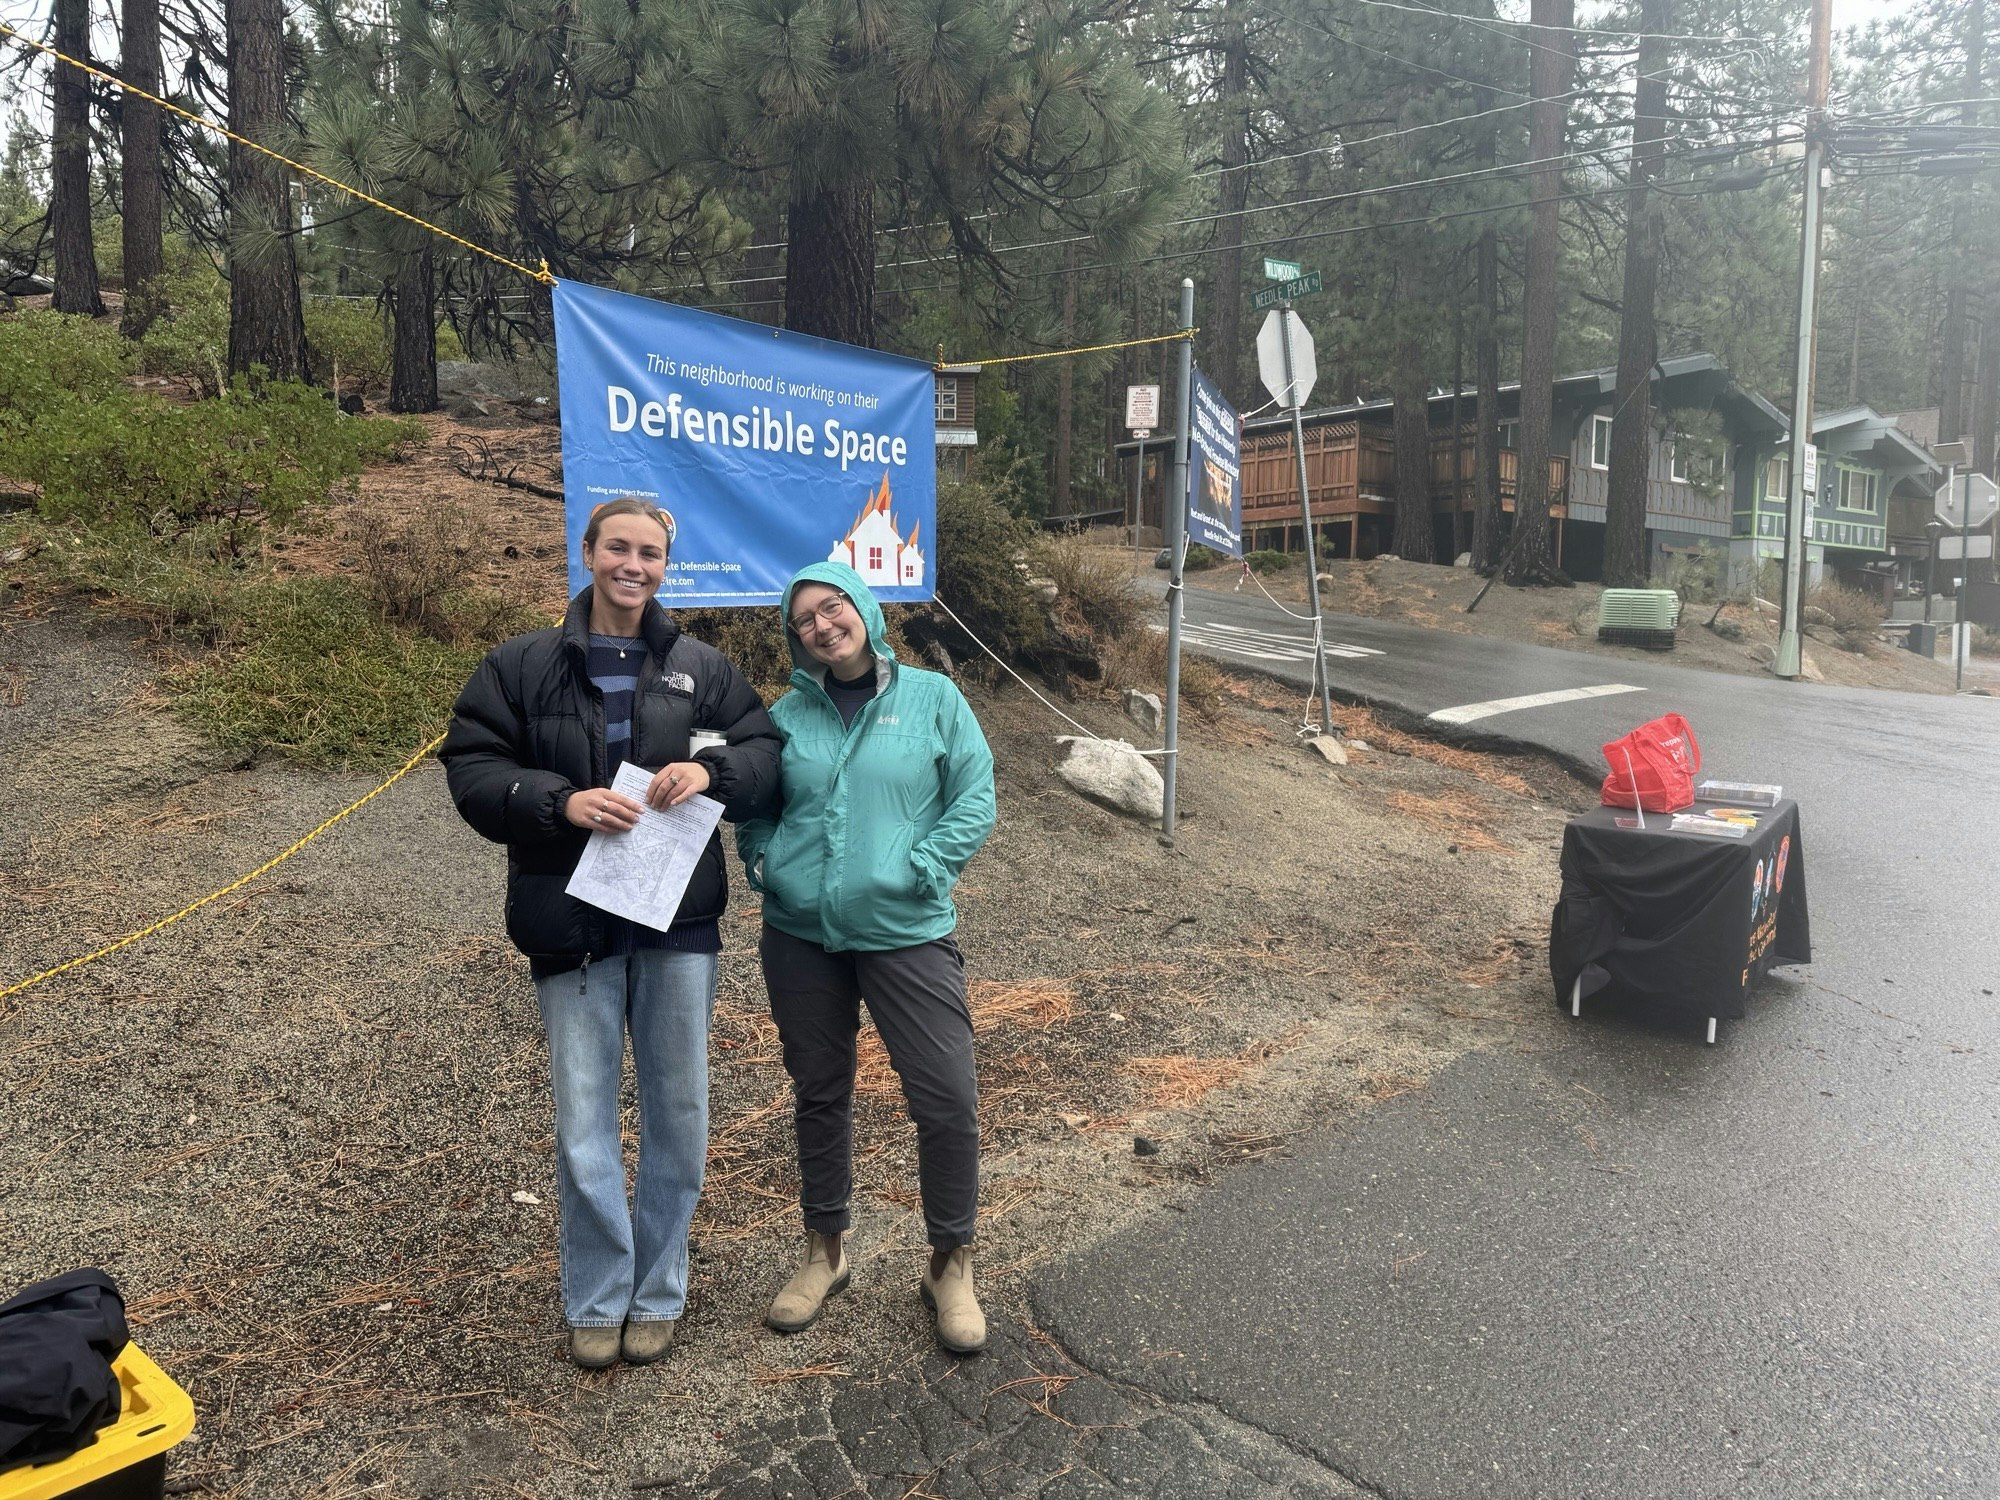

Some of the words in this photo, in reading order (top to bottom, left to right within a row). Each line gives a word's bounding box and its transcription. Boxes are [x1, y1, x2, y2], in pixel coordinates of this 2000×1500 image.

[1255, 286, 1284, 309] NEEDLE
[1286, 277, 1311, 298] PEAK
[647, 353, 676, 376] This
[680, 362, 774, 393] neighborhood
[776, 377, 786, 394] is
[789, 383, 834, 407] working
[837, 392, 851, 406] on
[854, 390, 879, 410] their
[607, 385, 815, 456] Defensible
[823, 418, 907, 472] Space
[586, 485, 608, 495] Funding
[609, 487, 618, 495] and
[620, 488, 636, 496] Project
[680, 561, 720, 571] Defensible
[721, 562, 742, 574] Space
[662, 675, 686, 685] NORTH
[672, 671, 686, 679] THE
[669, 682, 687, 690] FACE
